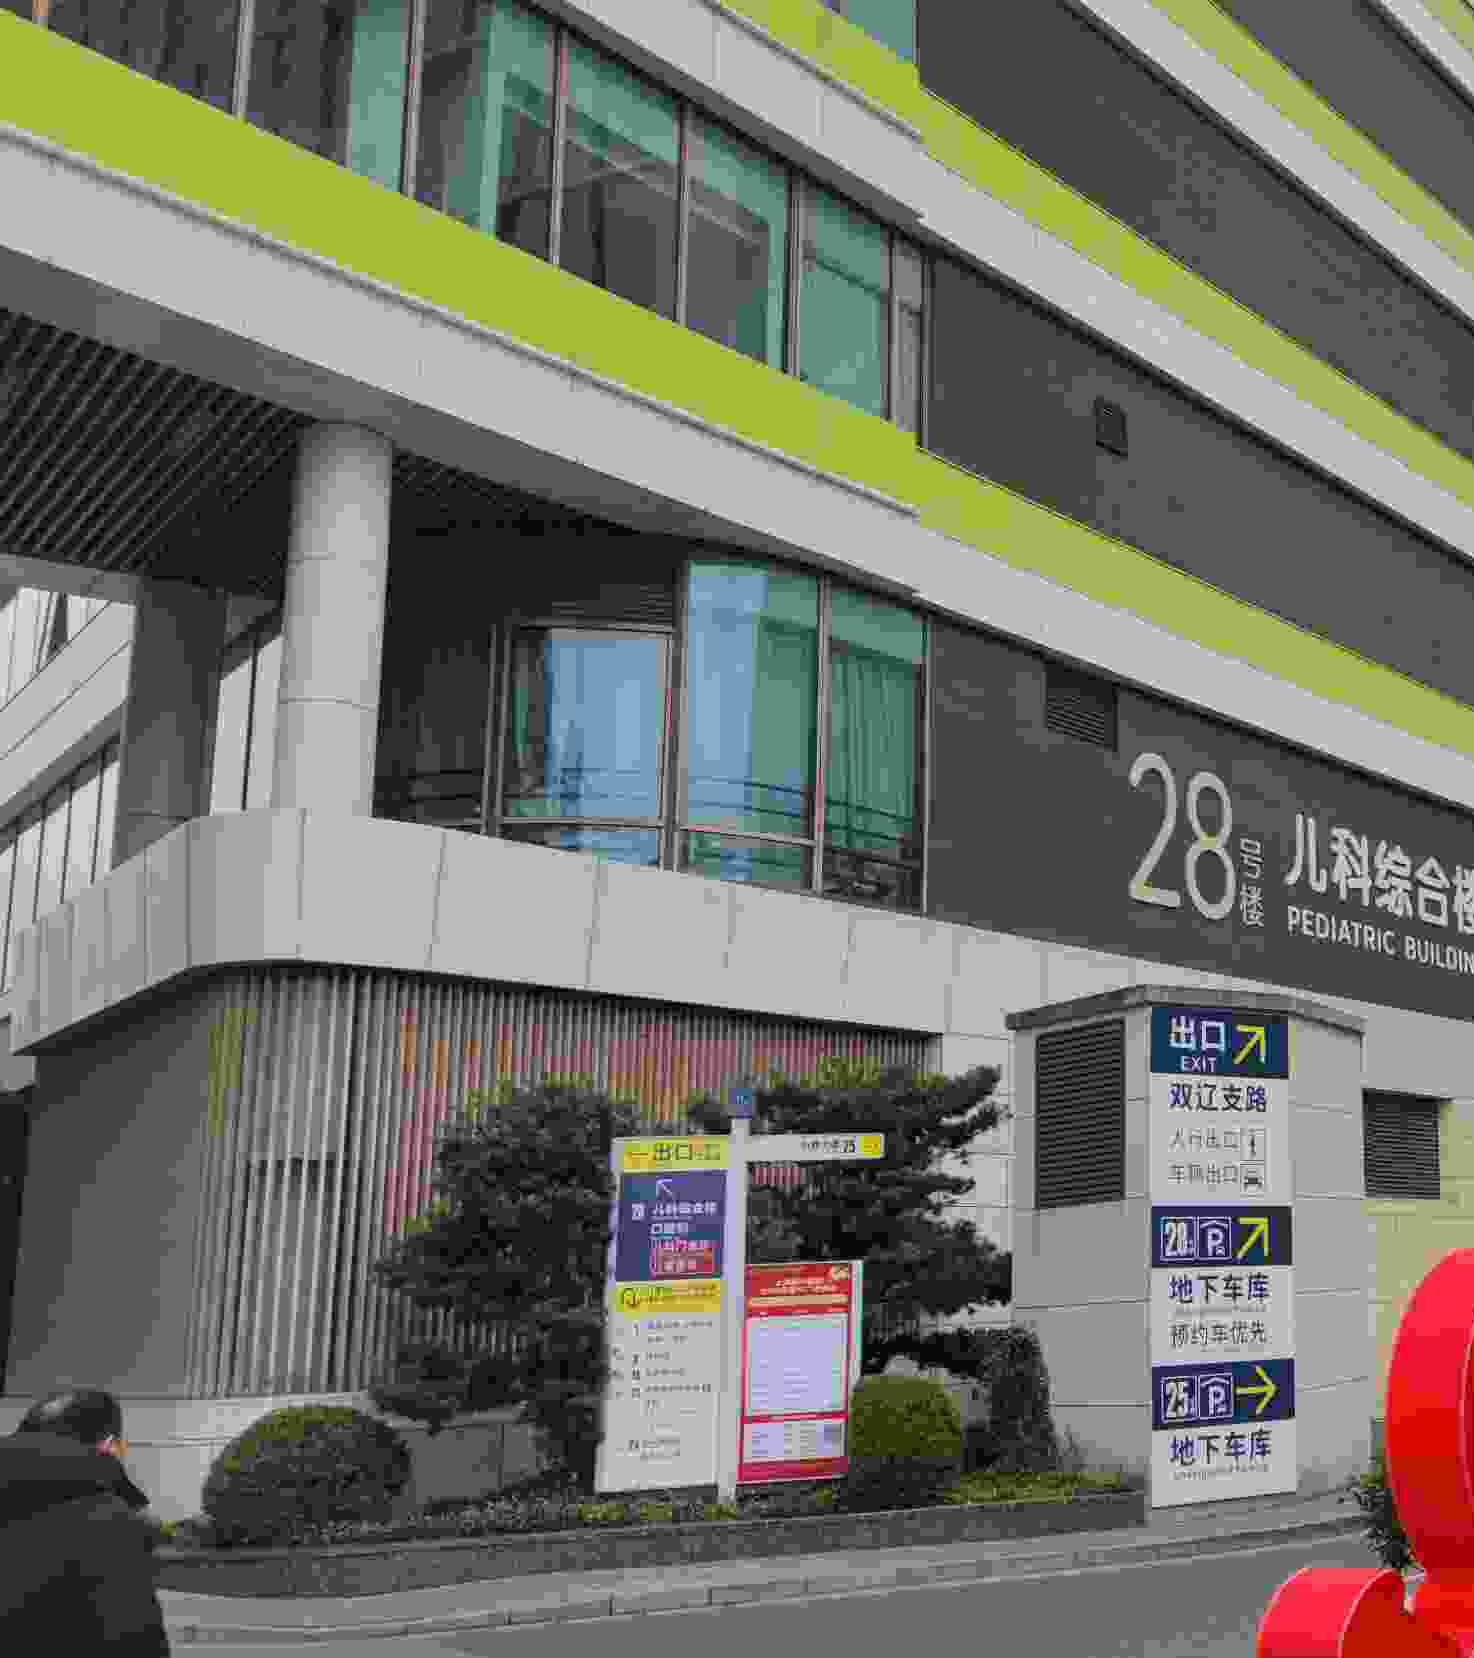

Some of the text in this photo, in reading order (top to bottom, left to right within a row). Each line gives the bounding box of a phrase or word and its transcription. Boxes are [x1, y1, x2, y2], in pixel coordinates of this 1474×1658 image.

[1127, 752, 1264, 928] 28 号楼
[1287, 905, 1396, 957] PEDIATRIC
[1169, 1015, 1226, 1051] 出口
[1181, 1055, 1217, 1073] EXIT
[1169, 1082, 1267, 1112] 双辽支路
[1169, 1128, 1240, 1151] 人行出口
[1169, 1272, 1270, 1304] 地下车库
[1170, 1320, 1268, 1348] 预约车优先
[1165, 1381, 1189, 1418] 25
[1170, 1429, 1271, 1467] 地下车库
